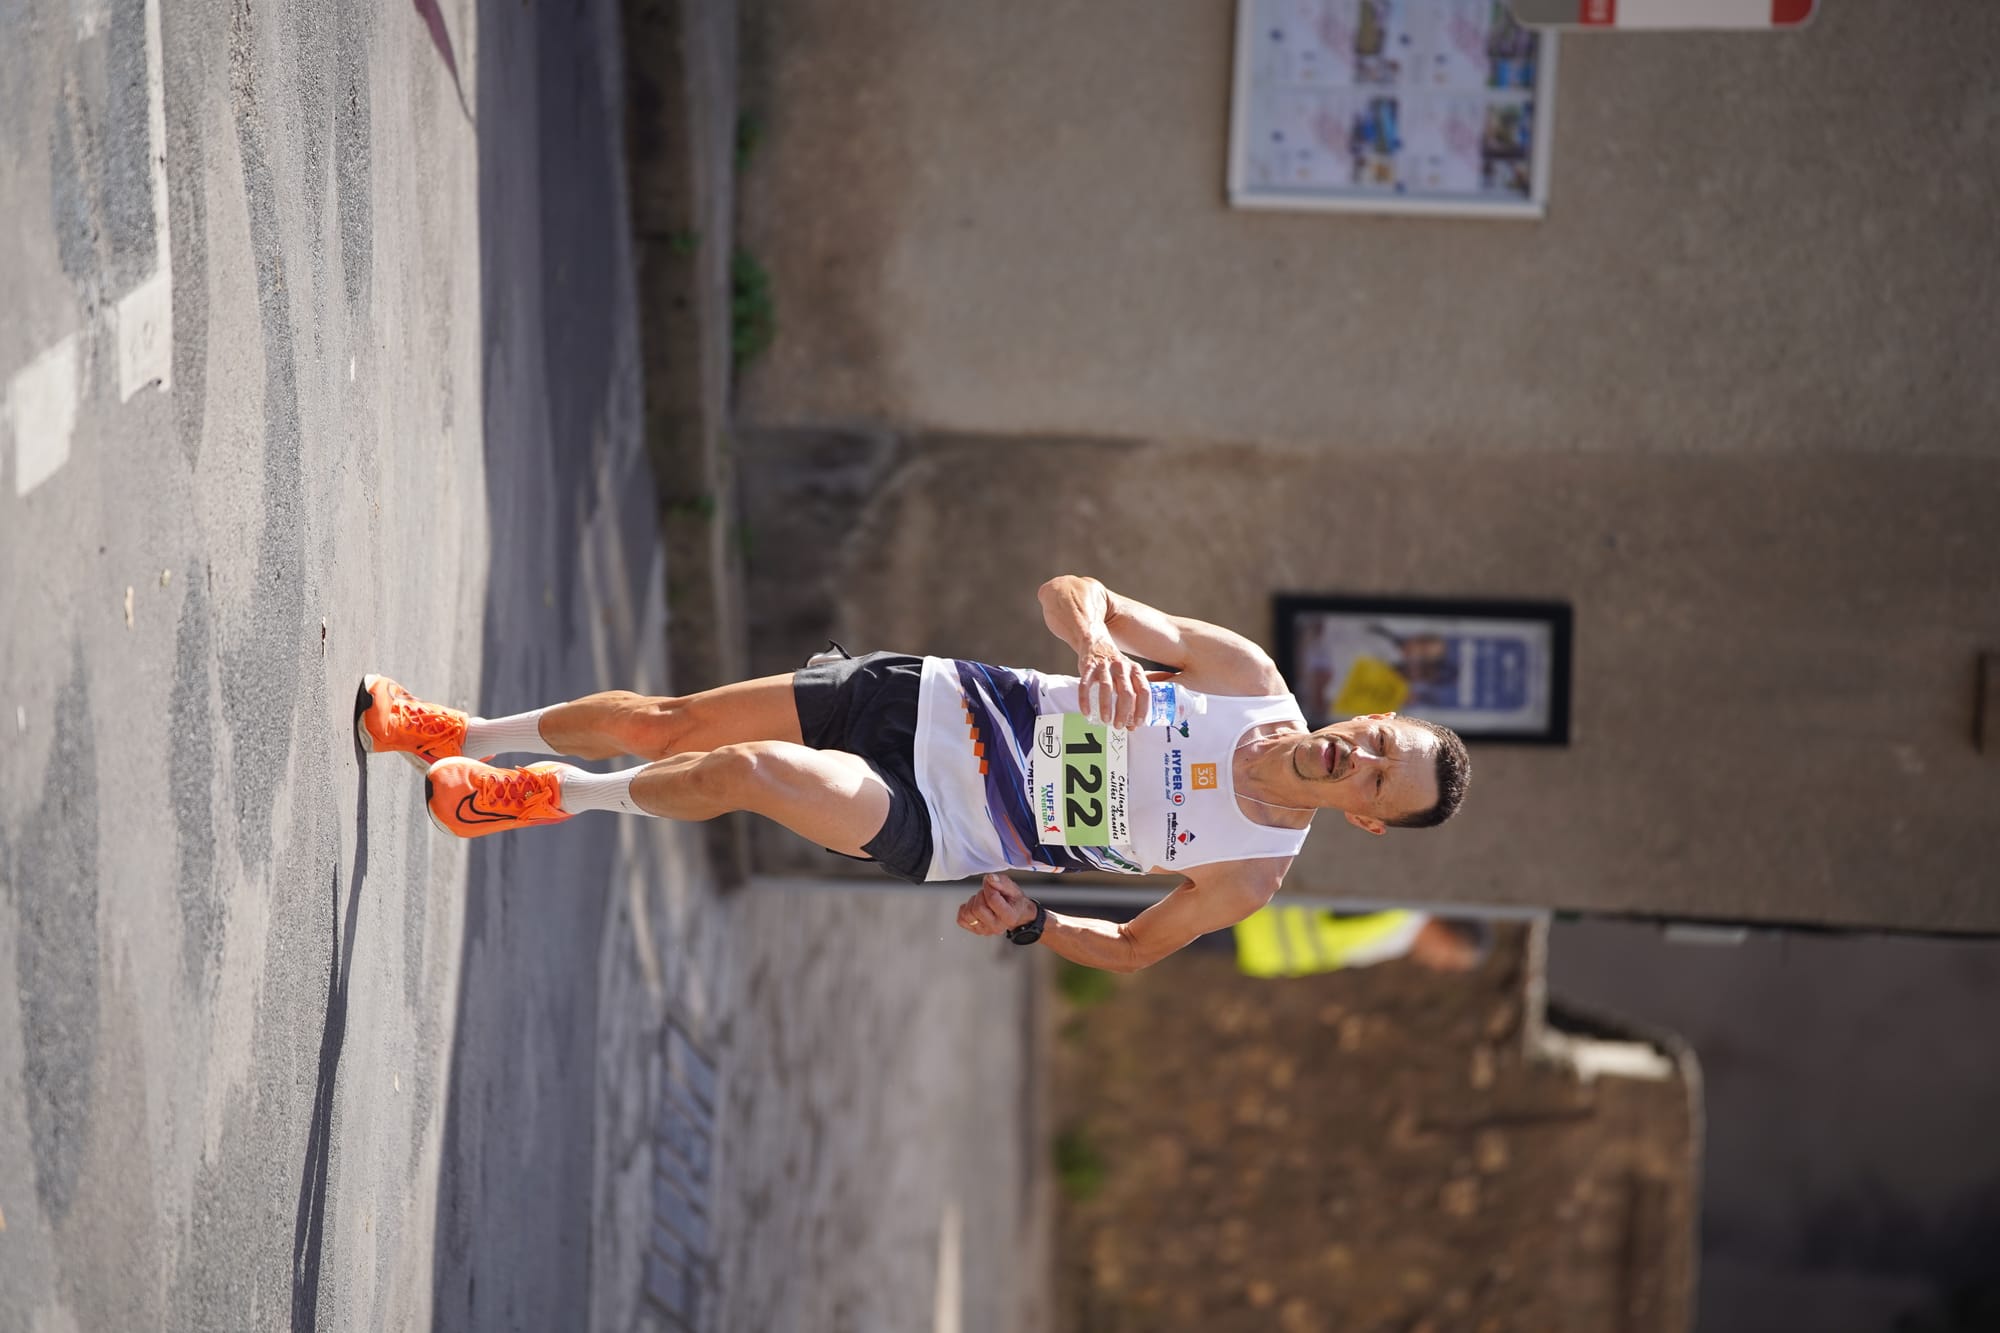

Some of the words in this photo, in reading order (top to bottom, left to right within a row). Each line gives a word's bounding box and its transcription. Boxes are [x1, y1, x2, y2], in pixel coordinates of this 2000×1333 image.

[1045, 726, 1054, 754] BFP
[1065, 732, 1103, 828] 122
[1110, 770, 1118, 800] vallées
[1172, 749, 1182, 791] HYPER
[1040, 786, 1049, 826] Aventure
[1046, 782, 1055, 822] TUFF'S
[1117, 775, 1126, 818] Challenge
[1119, 822, 1127, 836] des
